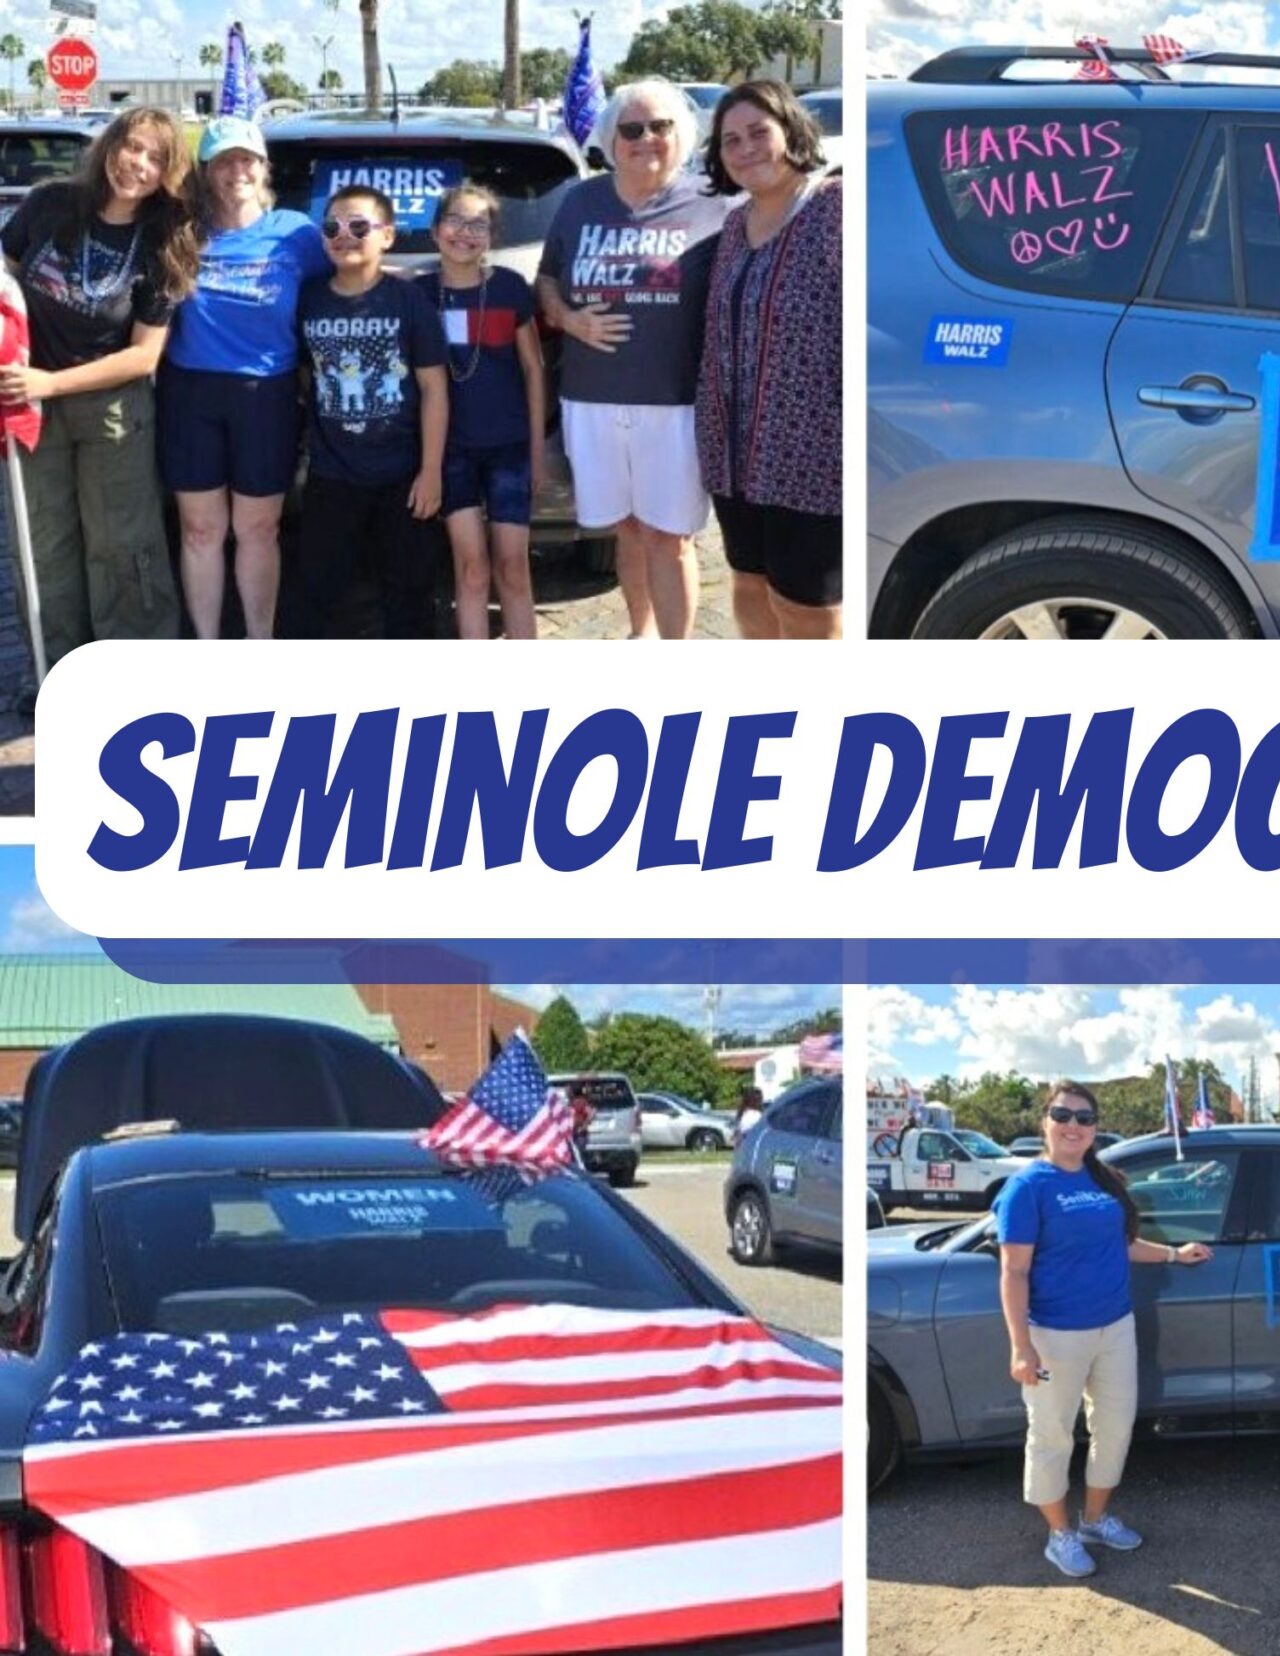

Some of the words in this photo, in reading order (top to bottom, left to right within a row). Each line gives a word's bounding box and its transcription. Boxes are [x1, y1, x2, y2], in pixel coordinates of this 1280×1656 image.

[51, 55, 96, 75] STOP
[944, 120, 1122, 169] HARRIS
[329, 168, 445, 196] HARRIS
[970, 165, 1134, 218] WALZ
[578, 224, 687, 256] HARRIS
[572, 258, 635, 287] WALZ
[304, 317, 401, 338] HOORAY
[934, 322, 1003, 346] HARRIS
[943, 345, 989, 359] WALZ
[295, 1189, 456, 1206] WOMEN
